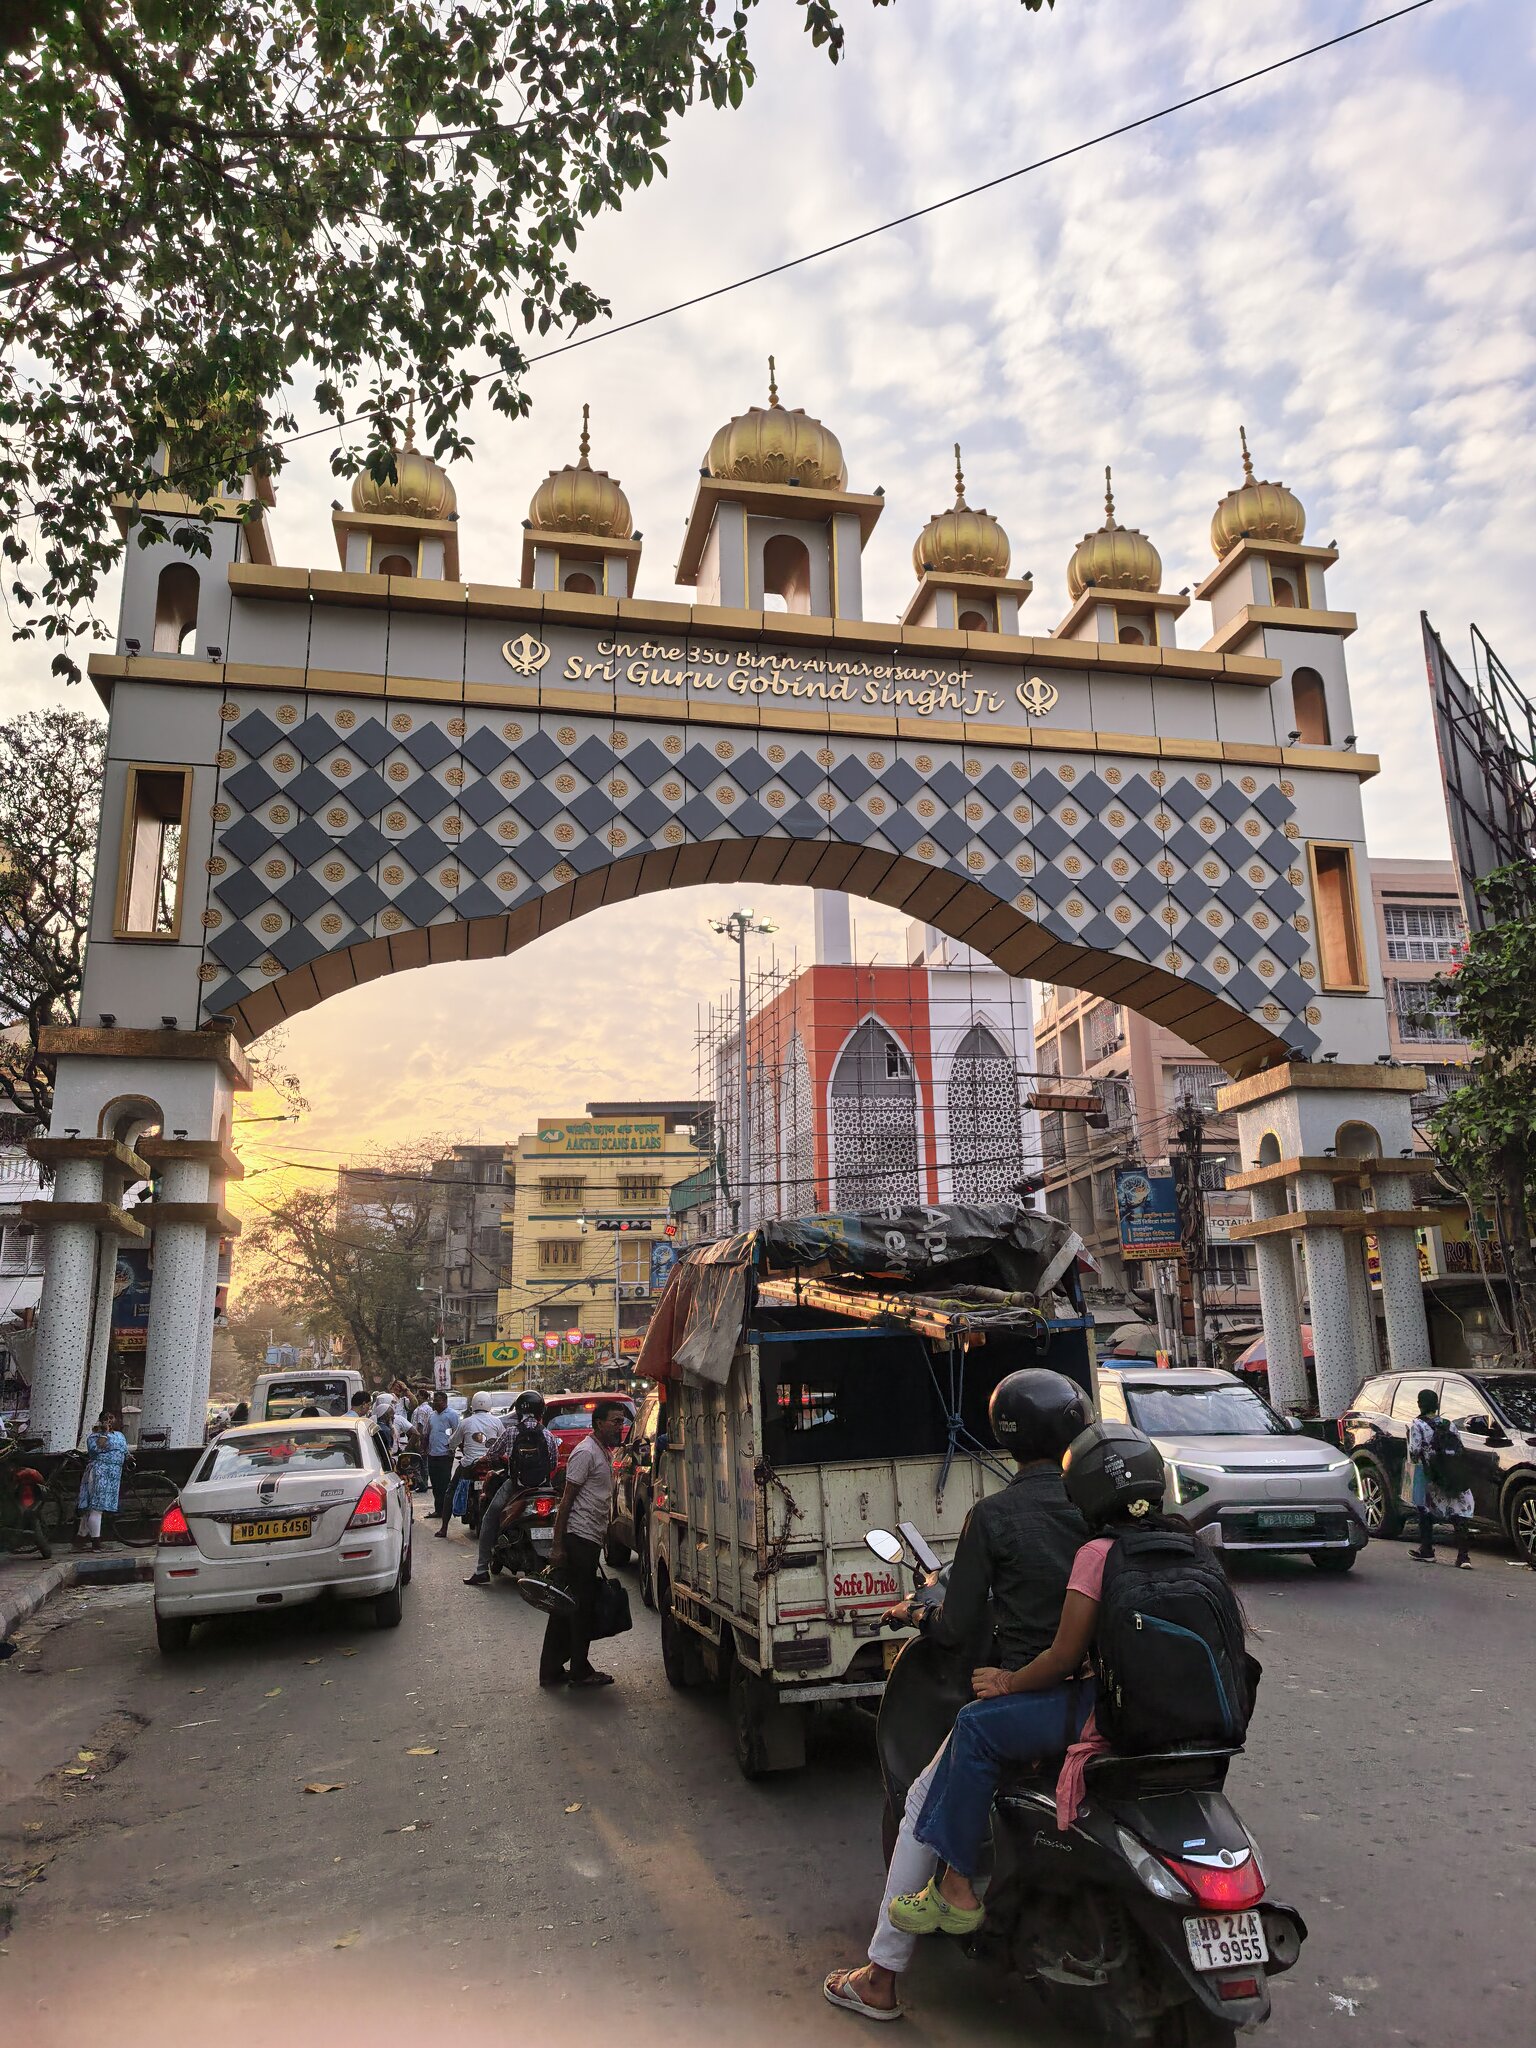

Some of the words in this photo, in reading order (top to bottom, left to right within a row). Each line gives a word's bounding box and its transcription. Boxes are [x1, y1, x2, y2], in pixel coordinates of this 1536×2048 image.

[598, 640, 640, 658] On
[688, 646, 730, 666] 350
[802, 658, 946, 687] Anniversary
[947, 668, 974, 689] of
[563, 655, 622, 682] Sri
[626, 660, 723, 689] Guru
[726, 669, 858, 702] Gobind
[861, 680, 966, 715] Singh
[964, 688, 1005, 716] Ji
[566, 1137, 600, 1150] AARTHI
[602, 1136, 629, 1150] SCANS
[630, 1136, 638, 1150] &
[639, 1136, 661, 1150] LABS
[241, 1524, 254, 1537] WB
[257, 1523, 270, 1536] 04
[281, 1520, 309, 1534] 6456
[833, 1572, 863, 1596] Safe
[863, 1571, 898, 1595] Drive
[1197, 1917, 1221, 1940] WB
[1219, 1938, 1262, 1964] 9955
